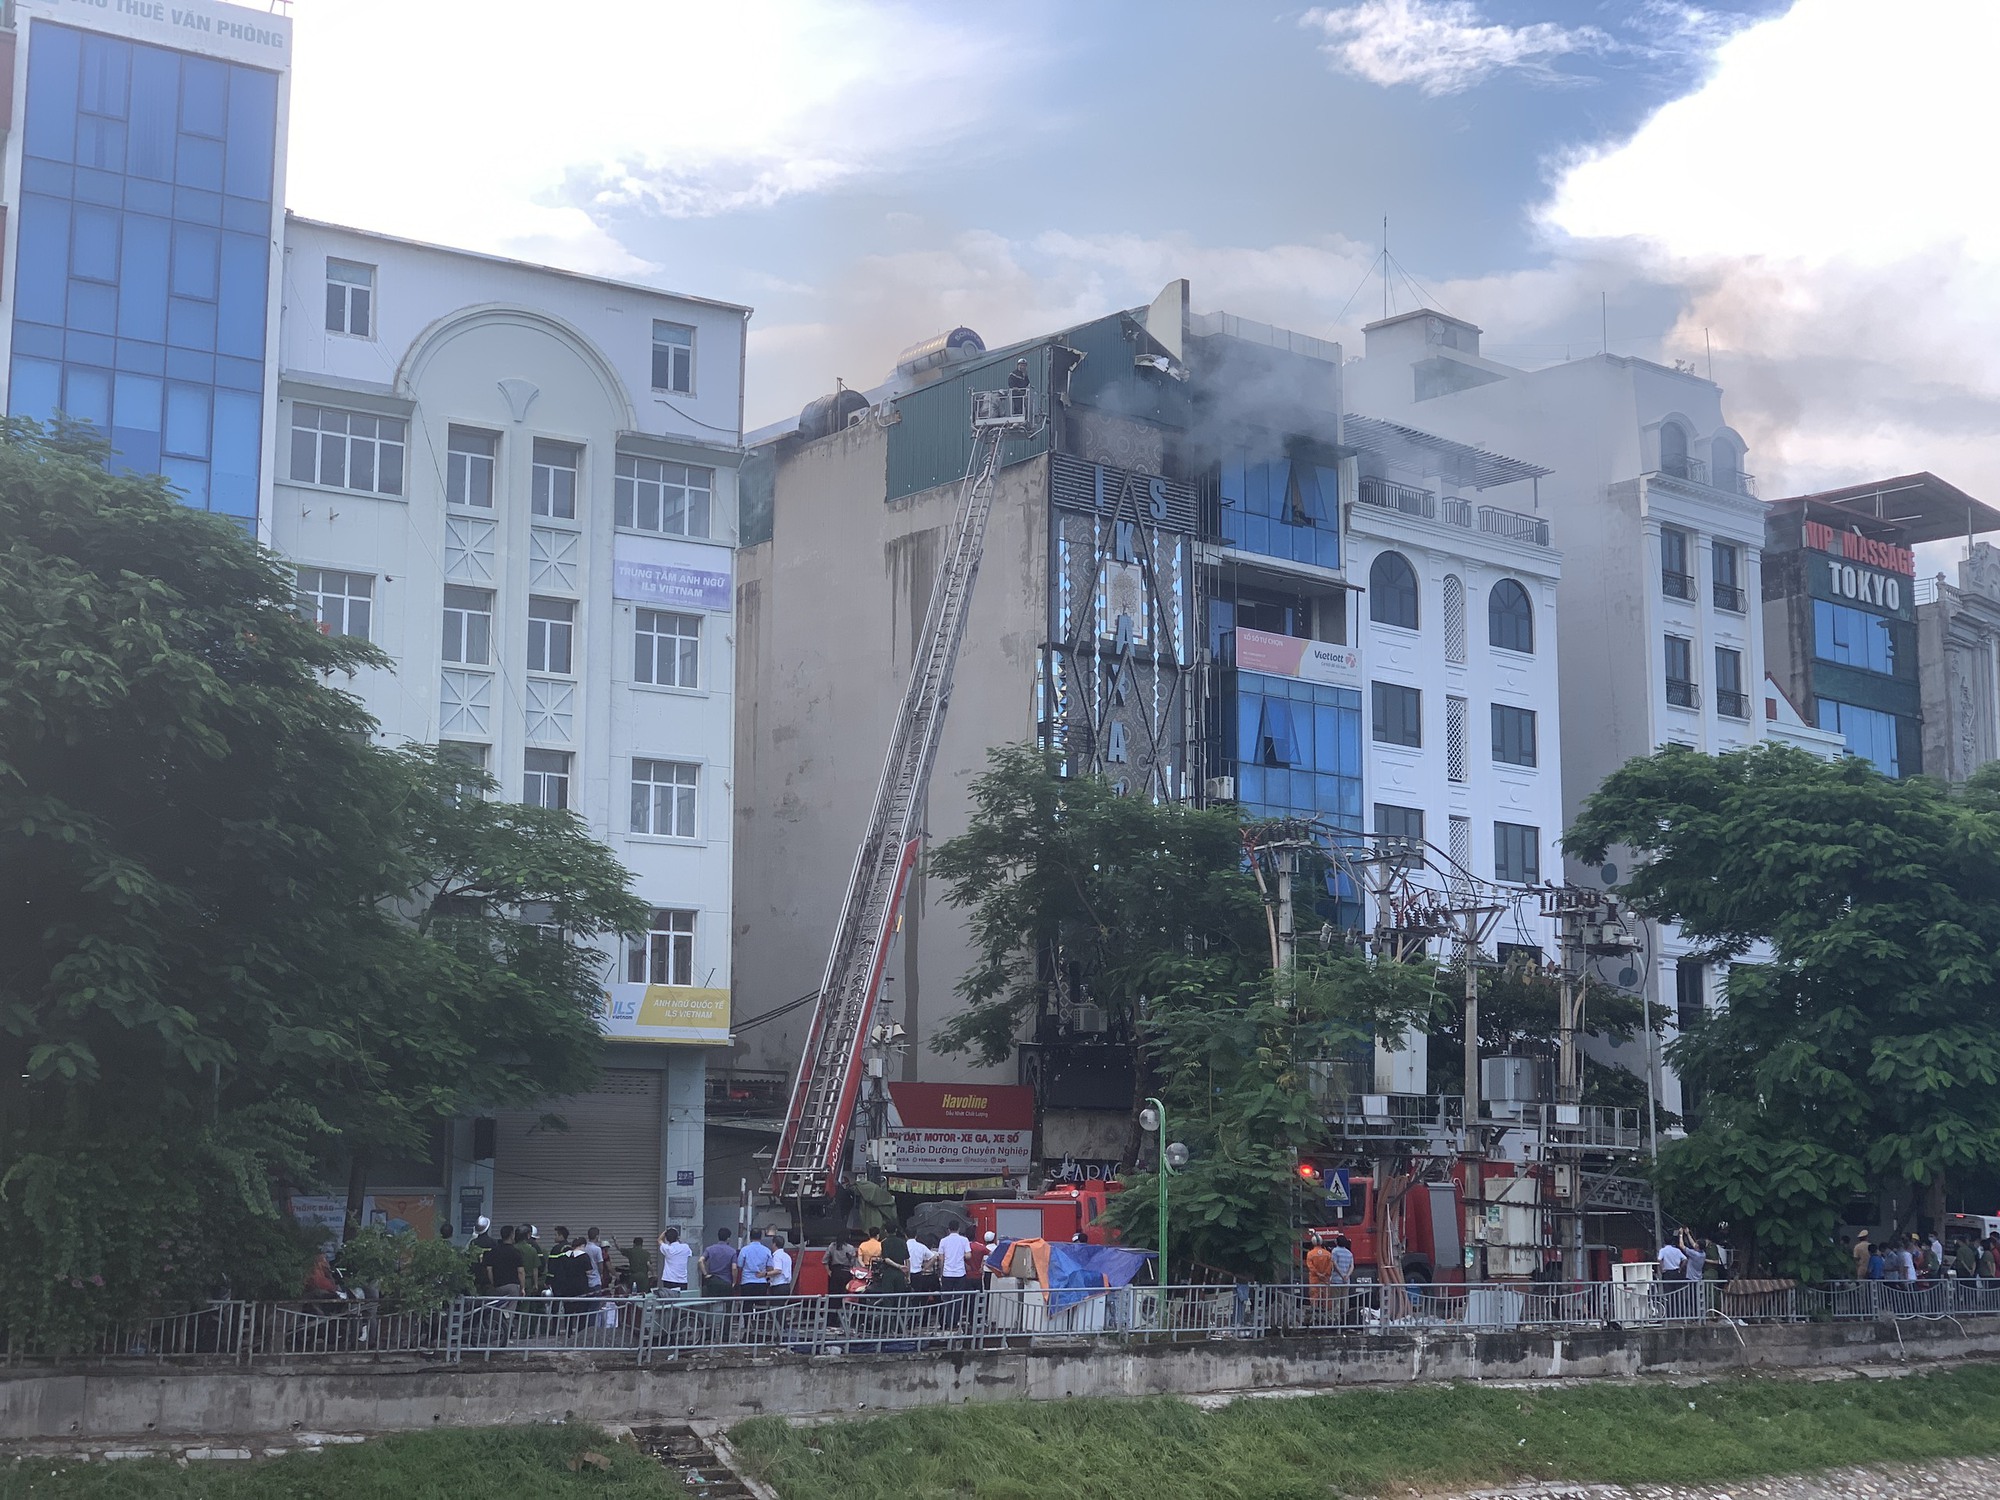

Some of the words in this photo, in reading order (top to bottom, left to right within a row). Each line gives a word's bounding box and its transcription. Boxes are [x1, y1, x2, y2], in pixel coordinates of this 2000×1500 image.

[171, 9, 210, 32] VĂN
[217, 19, 284, 48] PHÒNG
[1842, 531, 1916, 577] MASSAGE
[618, 566, 653, 580] TRUNG
[656, 570, 677, 582] TÂM
[679, 574, 701, 586] ANH
[641, 581, 657, 592] ILS
[659, 583, 703, 598] VIETNAM
[1828, 560, 1900, 611] TOKYO
[1314, 650, 1344, 663] Vietlott
[613, 1001, 636, 1015] ILS
[654, 1000, 671, 1008] ANH
[664, 1010, 678, 1018] ILS
[679, 1010, 713, 1019] VIETNAM
[942, 1093, 988, 1109] Havoline
[924, 1133, 956, 1142] MOTOR
[961, 1133, 973, 1142] XE
[993, 1134, 1005, 1143] XE
[1007, 1131, 1020, 1144] SỐ
[928, 1144, 959, 1156] Dưỡng
[998, 1146, 1029, 1157] Nghiệp
